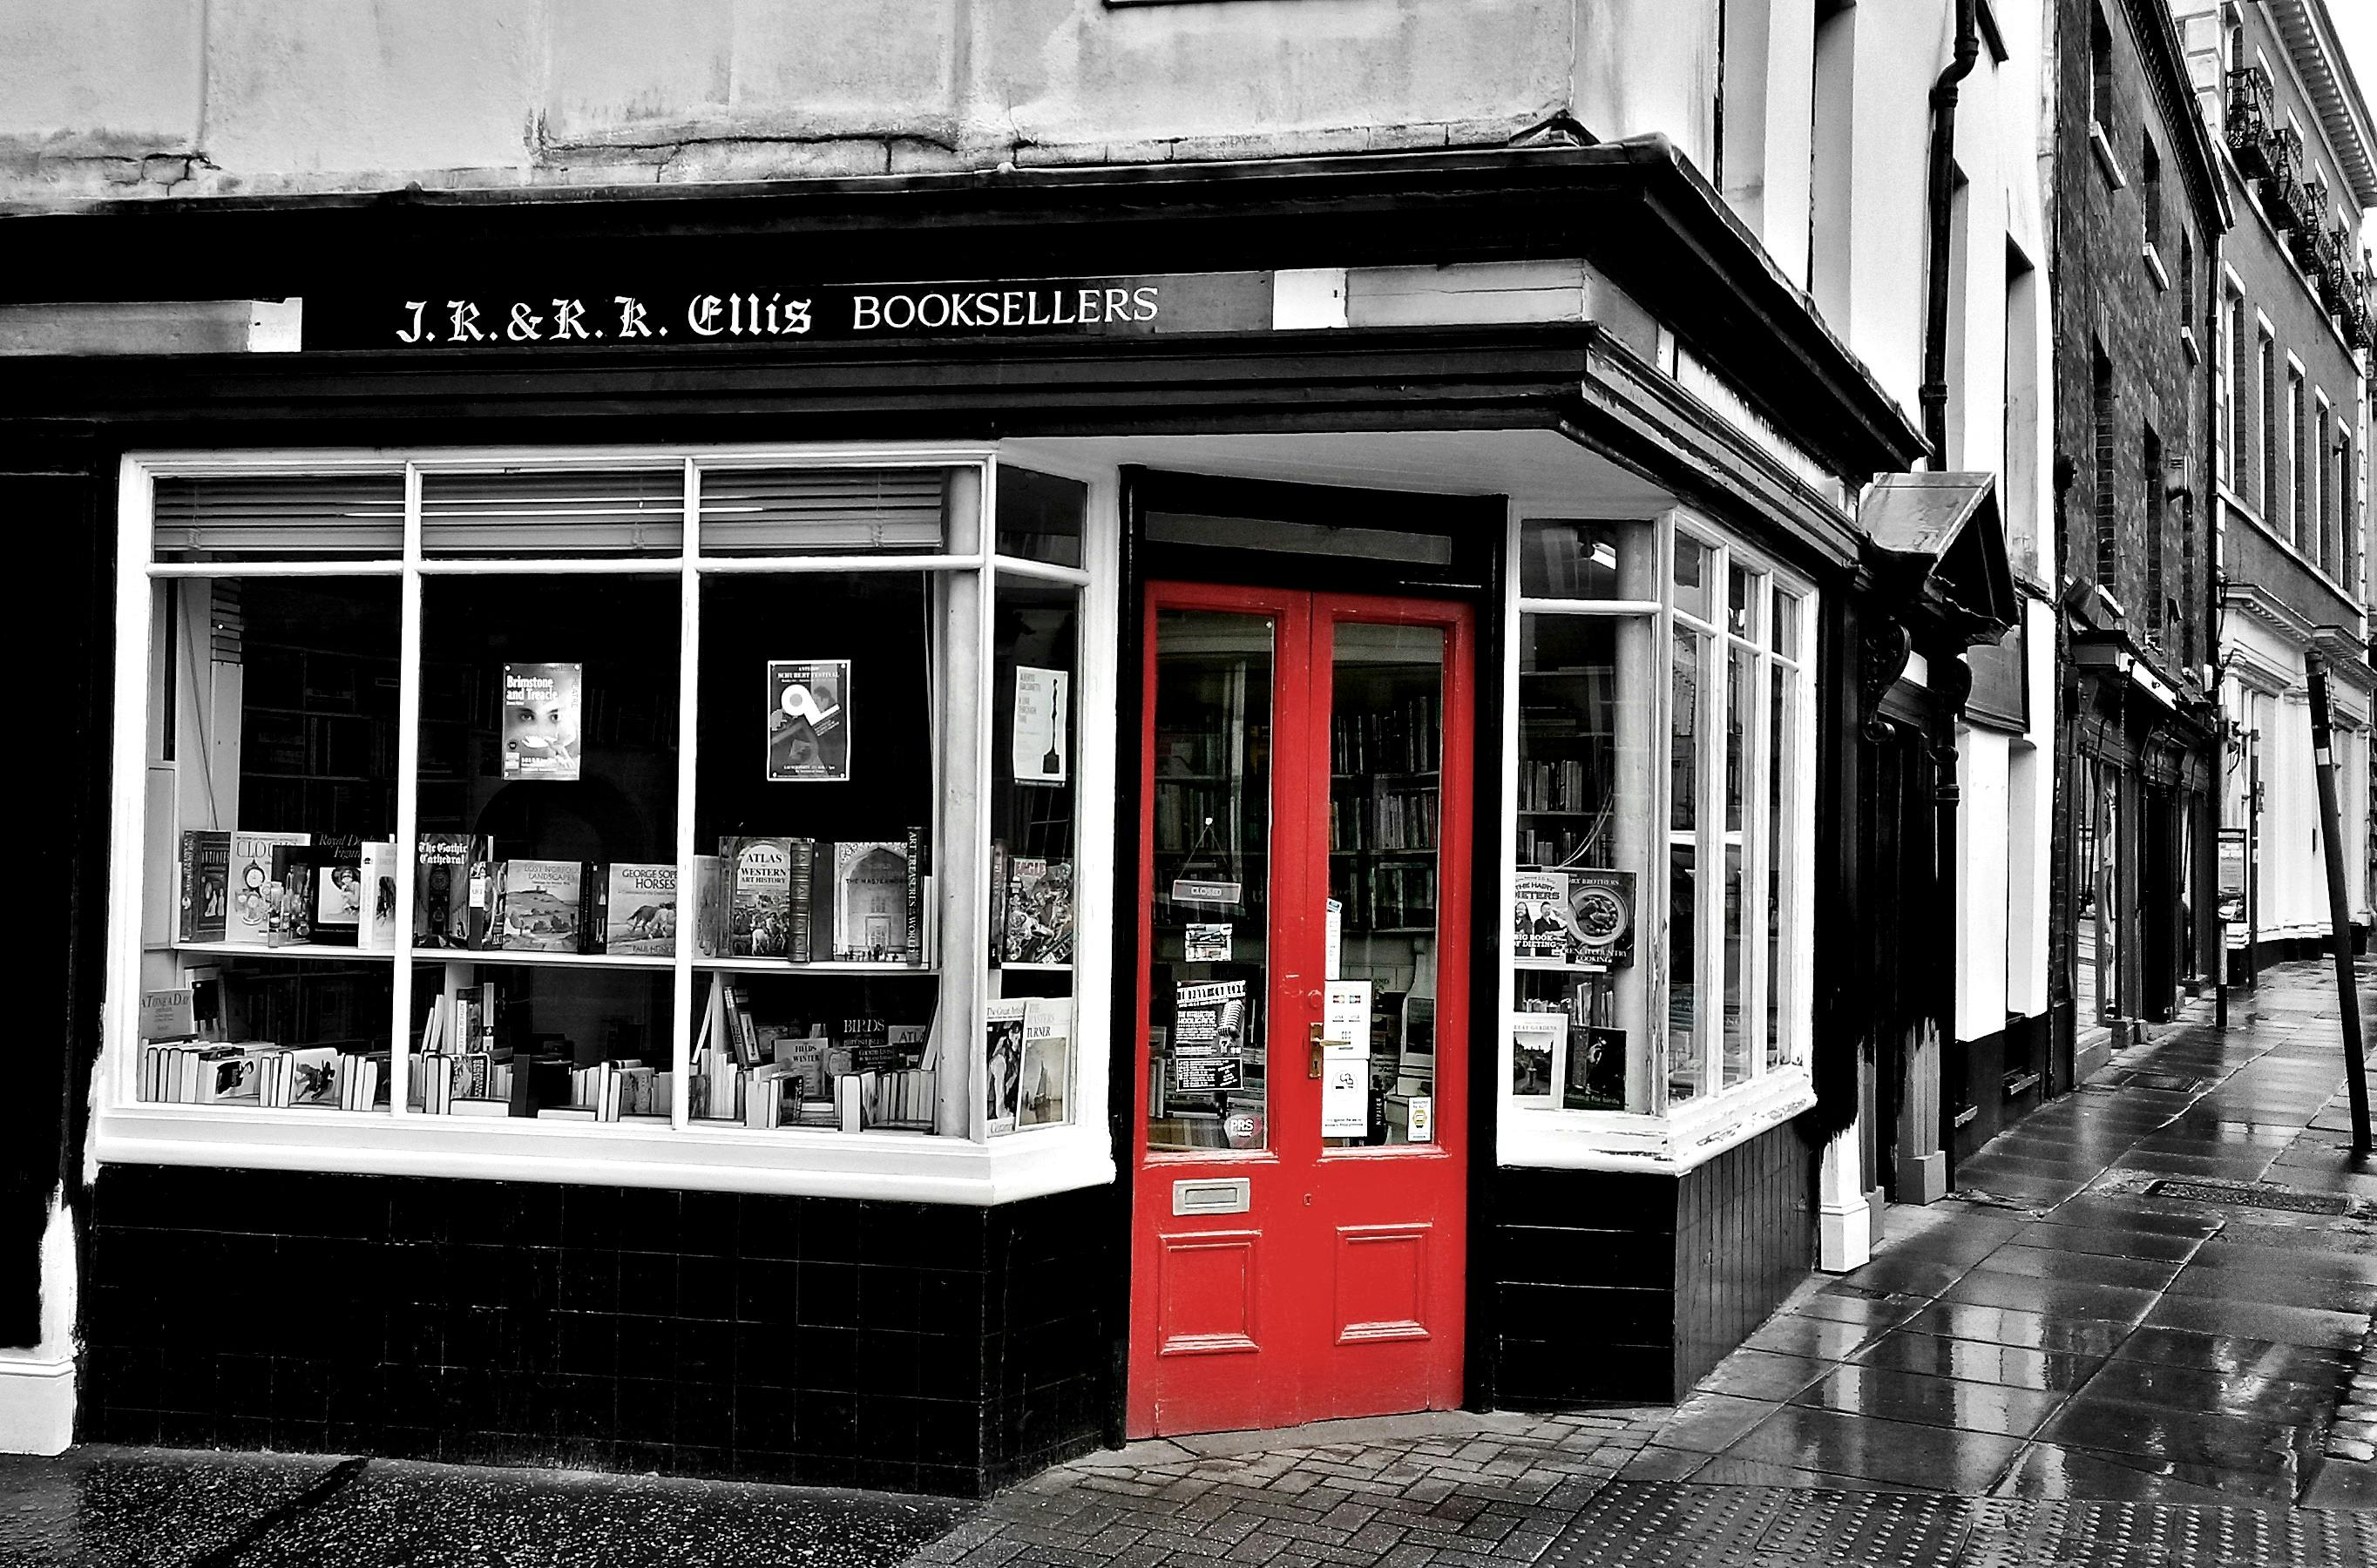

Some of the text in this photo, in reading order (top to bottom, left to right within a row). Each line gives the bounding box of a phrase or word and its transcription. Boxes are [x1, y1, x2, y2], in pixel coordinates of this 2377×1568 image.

[687, 293, 812, 336] Ellis
[853, 287, 1158, 329] BOOKSELLERS
[506, 674, 554, 688] Brimstone
[506, 688, 559, 700] and Treacle
[319, 834, 346, 848] Royal
[908, 831, 917, 848] ART
[418, 841, 468, 855] The Gothic
[420, 854, 465, 865] Cathedral
[747, 854, 782, 863] ATLAS
[622, 869, 657, 878] GEORGE
[741, 868, 786, 876] WESTERN
[635, 878, 675, 889] HORSES
[908, 853, 917, 907] TREASURES
[908, 916, 917, 953] WORLD
[843, 1018, 885, 1033] BIRDS
[1026, 1026, 1051, 1037] TURNER
[793, 1054, 820, 1063] WINTER
[1229, 1118, 1254, 1132] PRS
